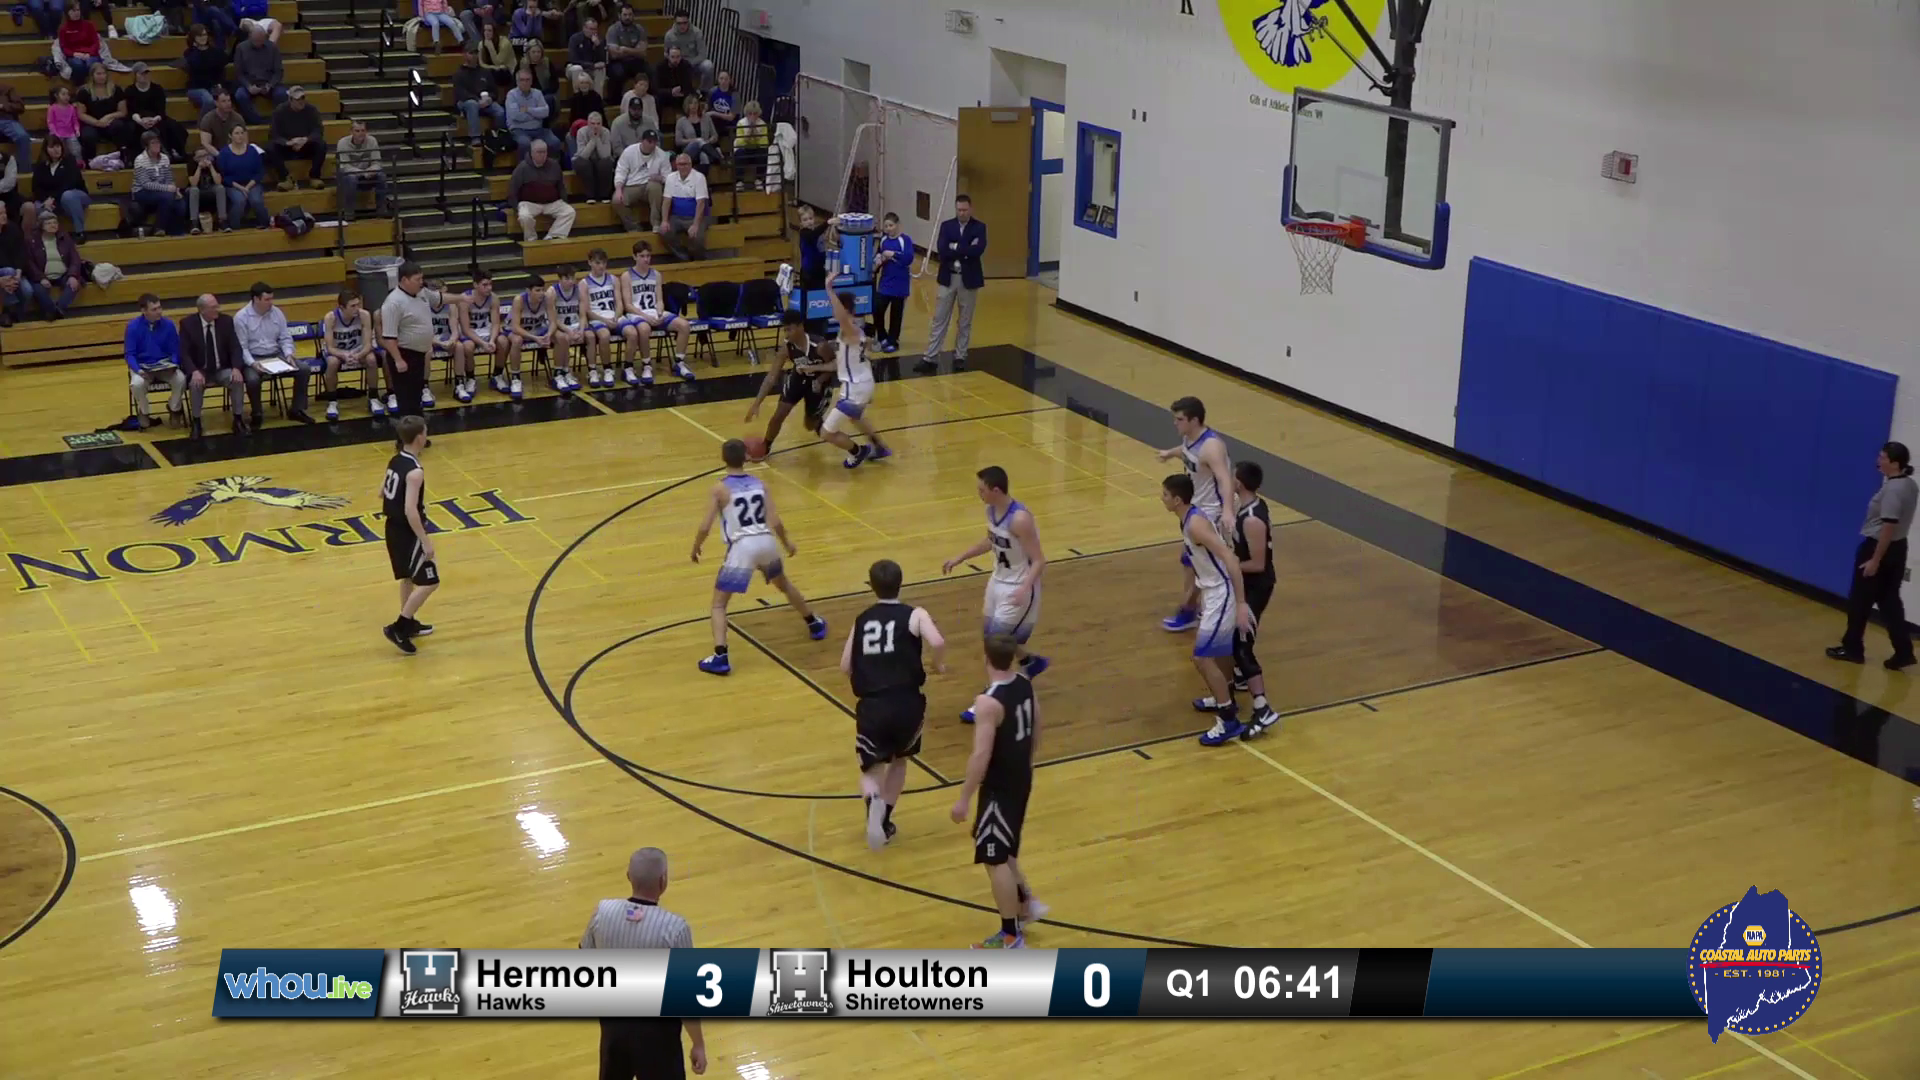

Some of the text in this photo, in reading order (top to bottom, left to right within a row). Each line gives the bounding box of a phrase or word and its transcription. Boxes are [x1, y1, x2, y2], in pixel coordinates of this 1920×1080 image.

[639, 294, 656, 310] 42
[734, 493, 767, 528] 22
[862, 619, 896, 656] 21
[1014, 698, 1032, 742] 11
